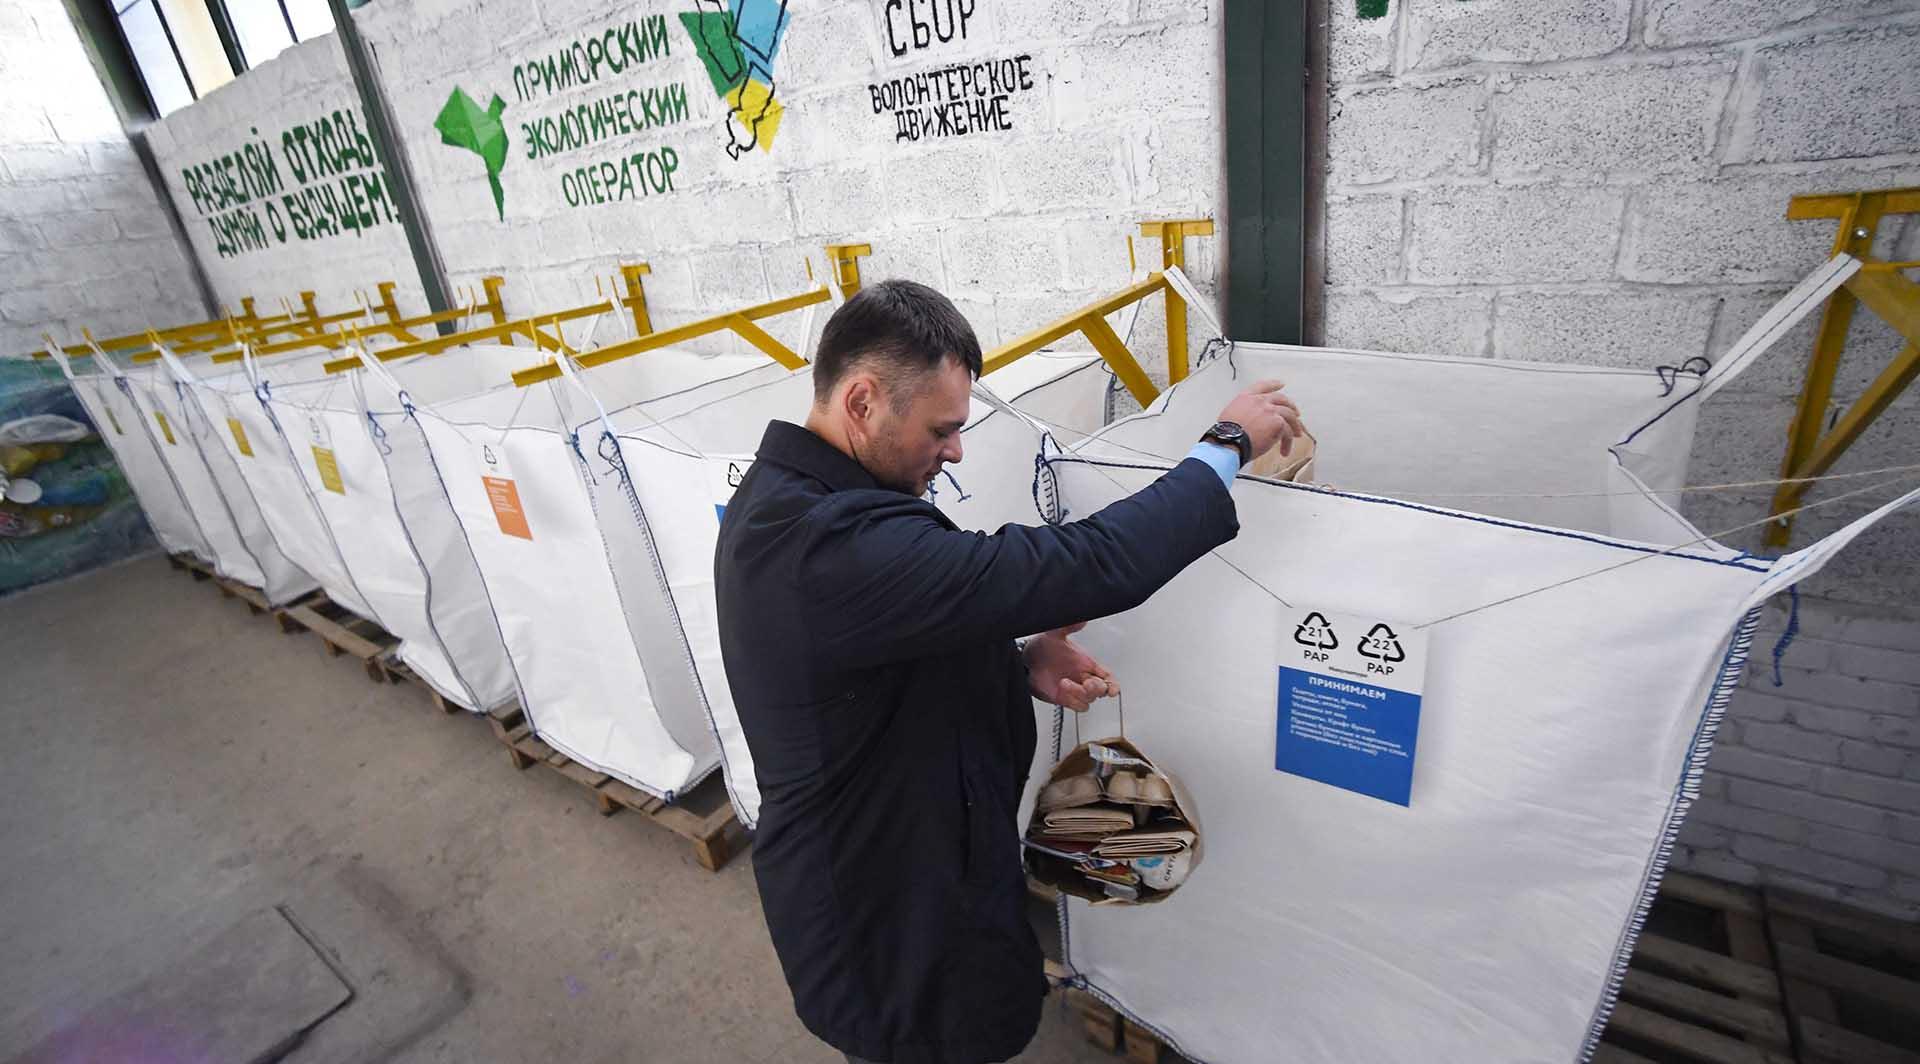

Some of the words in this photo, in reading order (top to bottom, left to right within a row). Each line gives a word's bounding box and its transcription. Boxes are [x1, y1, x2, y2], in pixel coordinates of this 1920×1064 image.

[886, 0, 975, 57] СБОР
[513, 14, 670, 102] ПРИМОРСКИЙ
[868, 55, 1033, 114] ВОЛОНТЁРСКОЕ
[521, 82, 690, 160] ЭКОЛОГИЧЕСКИЙ
[895, 95, 1013, 144] ДВИЖЕНИЕ
[182, 127, 284, 215] РАЗДЕЛЯЙ
[562, 146, 679, 207] ОПЕРАТОР
[208, 205, 269, 258] ДУМАЙ
[266, 201, 287, 243] О
[1304, 650, 1329, 662] PAP
[1308, 627, 1322, 638] 21
[1373, 638, 1390, 650] 22
[1309, 676, 1386, 700] ПРИНИМАЕМ
[1367, 662, 1394, 676] PAP
